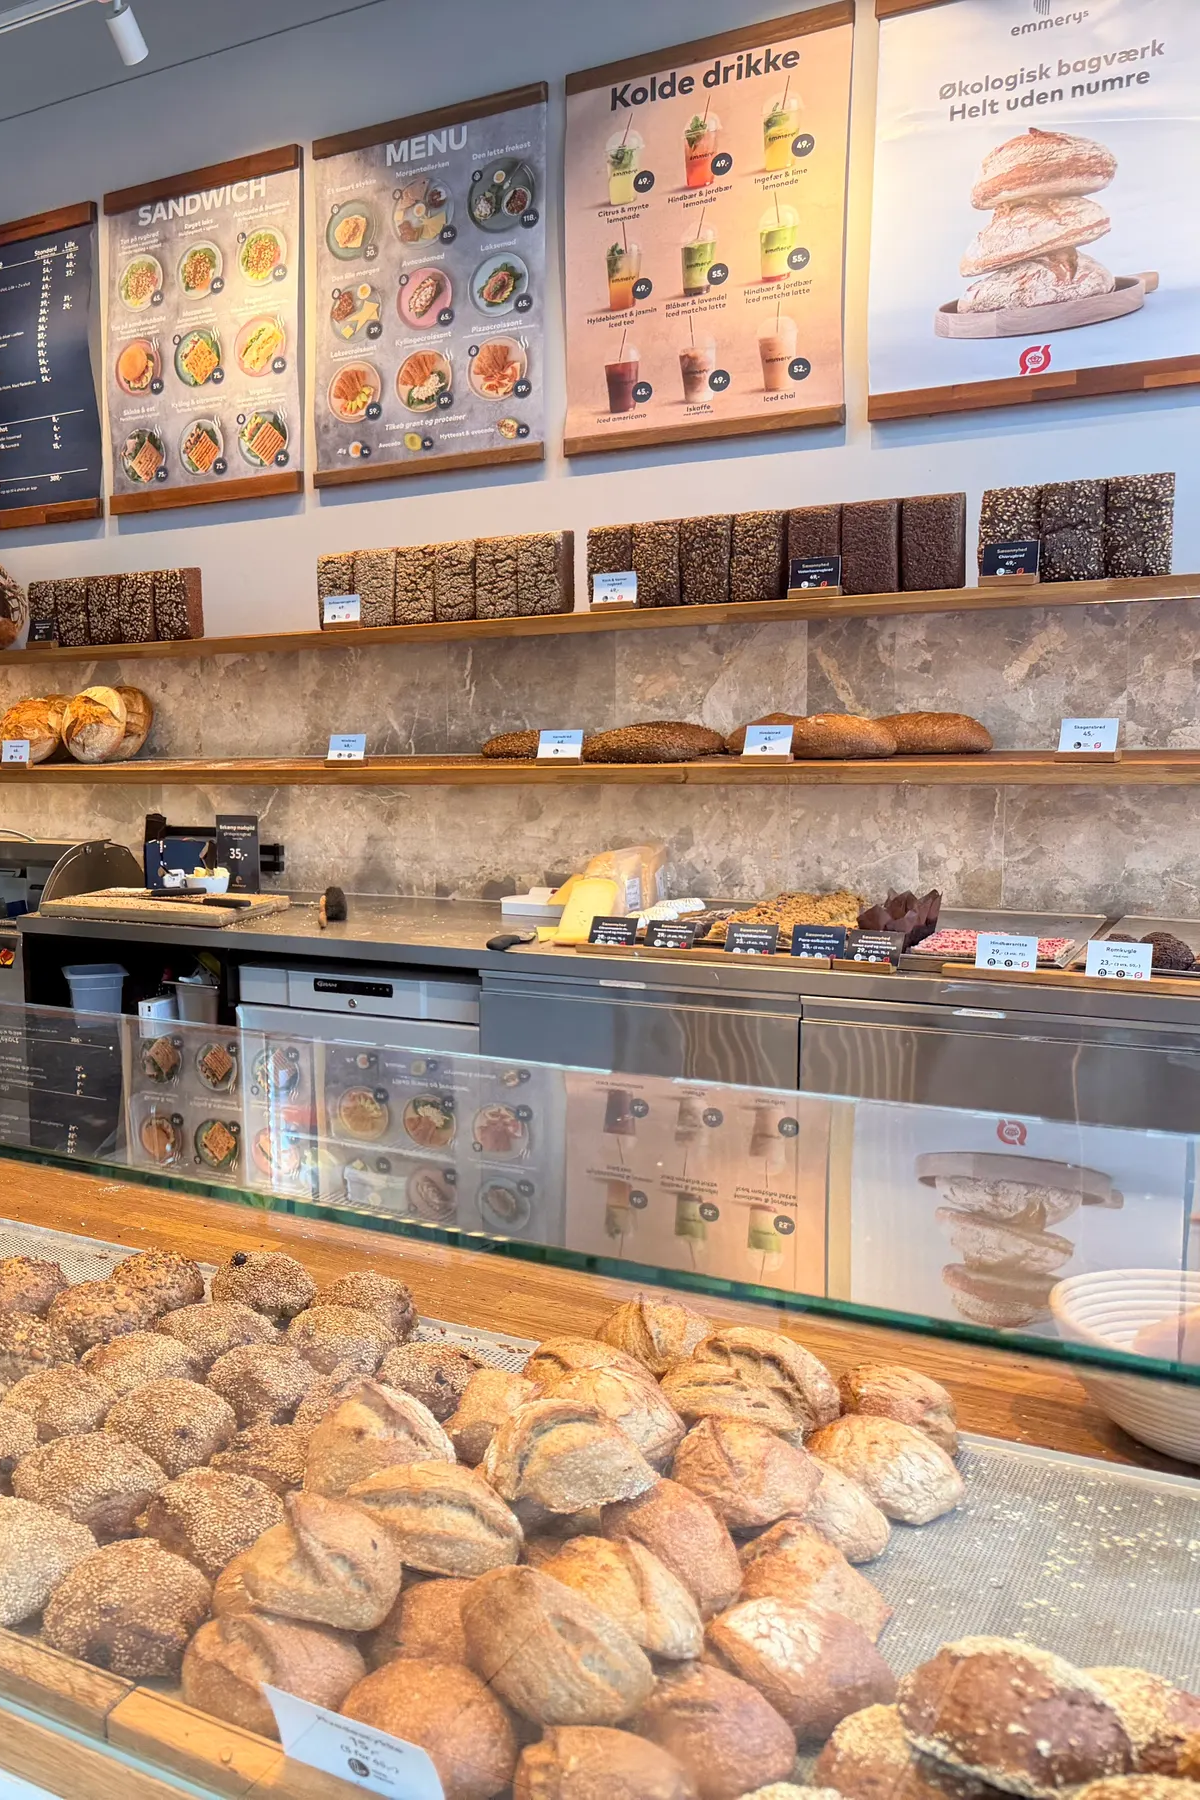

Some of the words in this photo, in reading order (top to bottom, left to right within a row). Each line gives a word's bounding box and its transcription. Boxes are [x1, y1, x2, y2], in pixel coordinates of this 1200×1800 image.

[1011, 9, 1089, 37] emmerys
[938, 58, 1053, 101] Økologisk
[1057, 39, 1166, 76] bagværk
[610, 72, 695, 112] Kolde
[702, 48, 800, 89] drikke
[949, 98, 1000, 122] Helt
[1006, 86, 1064, 112] uden
[1070, 70, 1151, 99] numre
[386, 125, 469, 167] MENU
[472, 152, 487, 161] Den
[487, 148, 504, 157] lette
[395, 160, 450, 179] Morgentallerken
[754, 174, 784, 185] Ingefær
[784, 171, 790, 179] &
[792, 167, 808, 177] lime
[762, 178, 799, 191] lemonade
[138, 177, 266, 227] SANDWICH
[667, 192, 697, 204] Hindbær
[698, 190, 704, 198] &
[704, 184, 733, 198] jordbær
[598, 208, 620, 218] Citrus
[620, 206, 626, 214] &
[627, 202, 650, 215] mynte
[683, 196, 716, 209] lemonade
[606, 212, 640, 224] lemonade
[480, 239, 517, 251] Laksemad
[401, 253, 445, 268] Avocadomad
[743, 286, 775, 296] Hindbær
[783, 279, 813, 290] jordbær
[746, 296, 761, 304] Iced
[762, 291, 790, 301] matcha
[791, 287, 811, 297] latte
[665, 300, 691, 310] Blåbær
[698, 293, 728, 305] lavendel
[587, 312, 629, 325] Hyldeblomst
[635, 307, 658, 319] jasmin
[665, 310, 680, 318] Iced
[681, 306, 708, 317] matcha
[709, 302, 727, 311] latte
[471, 319, 523, 333] Pizzacroissant
[608, 320, 623, 329] Iced
[623, 319, 635, 327] tea
[330, 345, 377, 358] Laksecroissant
[763, 394, 780, 402] Iced
[781, 391, 796, 400] chai
[686, 404, 711, 413] Iskaffe
[611, 412, 647, 422] americano
[229, 847, 248, 861] 35,-
[1106, 947, 1137, 955] Romkugle
